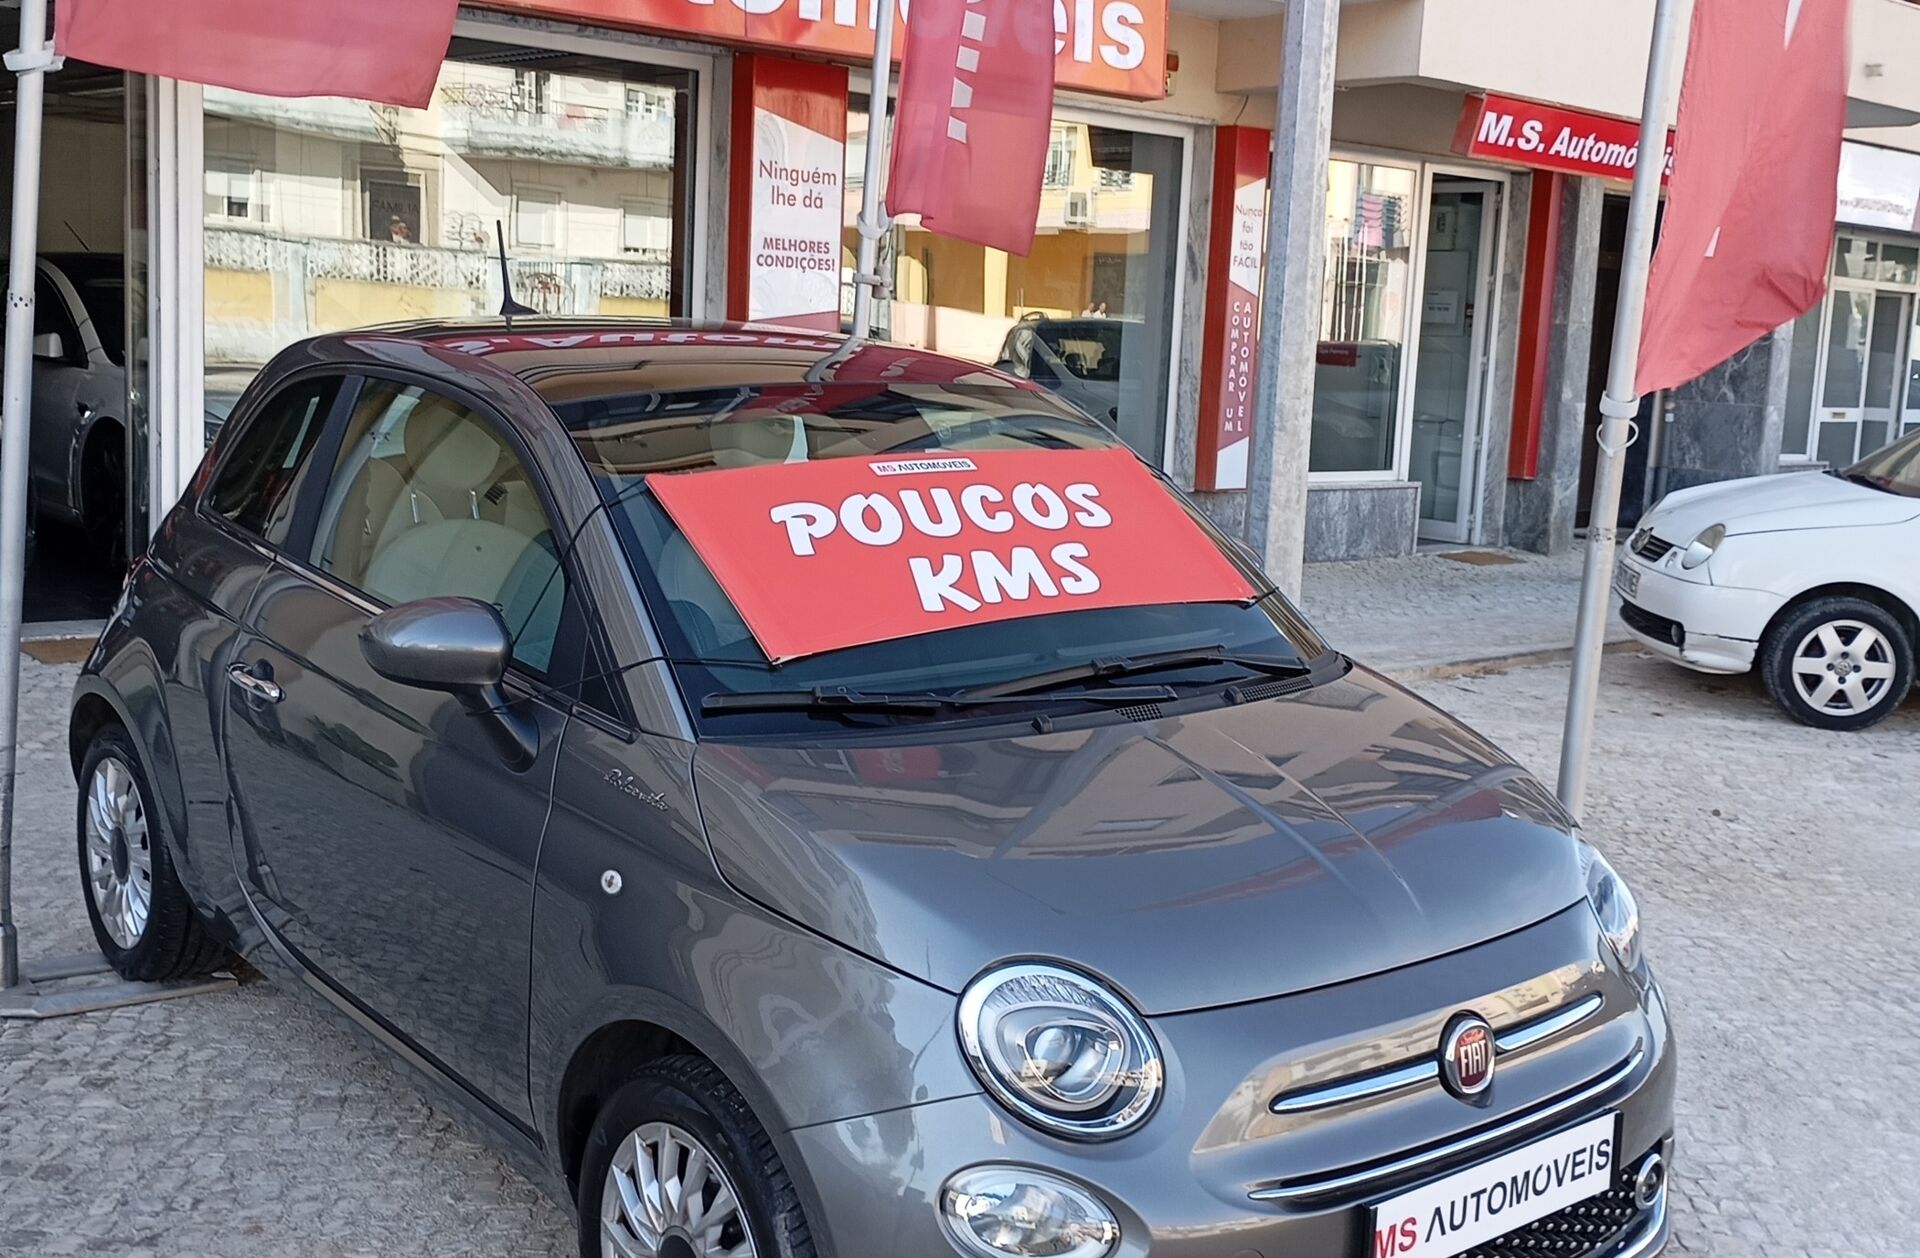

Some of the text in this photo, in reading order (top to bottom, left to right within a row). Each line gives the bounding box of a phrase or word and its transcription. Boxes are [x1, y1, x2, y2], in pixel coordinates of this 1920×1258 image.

[1477, 110, 1545, 154] M.S.
[759, 159, 837, 187] Ninguém
[771, 185, 824, 209] lhe dá
[1235, 204, 1263, 217] Nunca
[1242, 221, 1254, 233] foi
[762, 237, 830, 254] MELHORES
[756, 253, 836, 273] CONDIÇÕES!
[1224, 301, 1241, 432] COMPRAR UM
[1237, 302, 1252, 432] AUTOMÓVEL
[876, 464, 897, 472] MS
[769, 482, 1113, 557] POUCOS
[908, 541, 1101, 612] KMS
[1460, 1040, 1486, 1078] FIAT
[1374, 1216, 1417, 1258] MS
